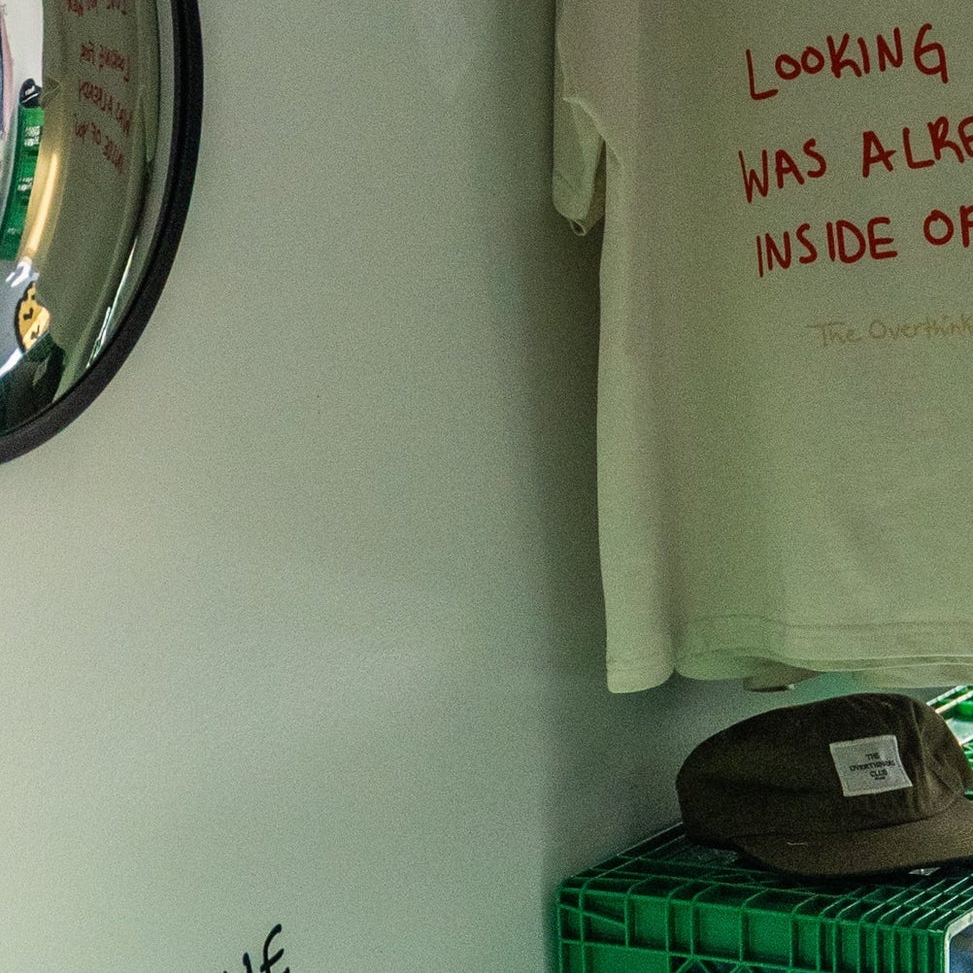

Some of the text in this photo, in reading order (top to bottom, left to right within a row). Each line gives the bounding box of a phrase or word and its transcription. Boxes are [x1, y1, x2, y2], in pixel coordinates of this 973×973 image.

[746, 23, 948, 100] LOOKING
[739, 138, 827, 202] WAS
[756, 216, 898, 278] INSIDE
[805, 320, 863, 348] The
